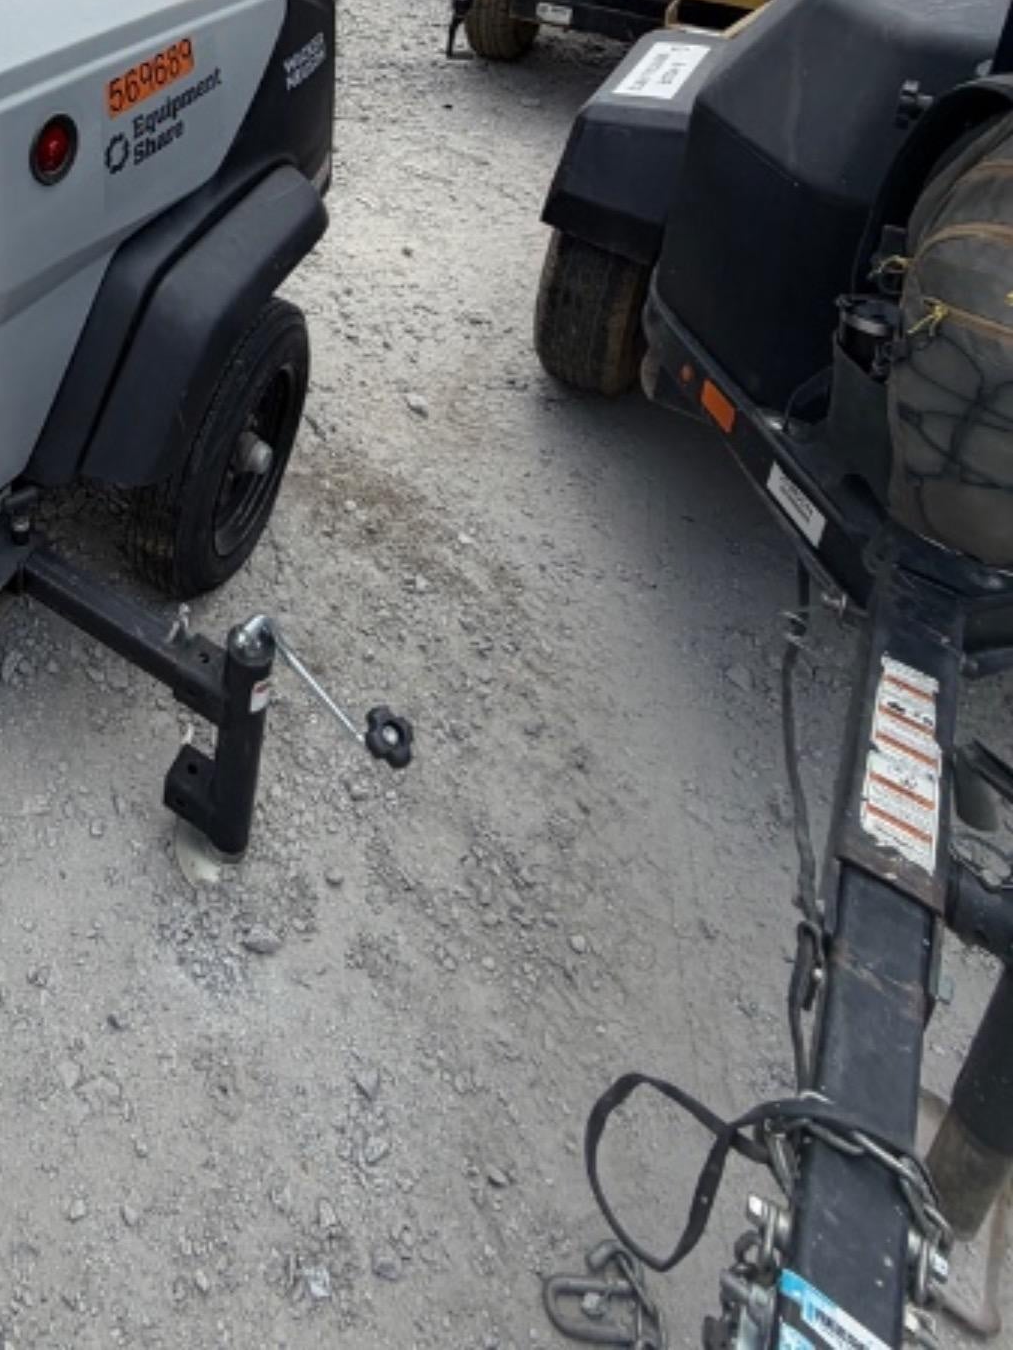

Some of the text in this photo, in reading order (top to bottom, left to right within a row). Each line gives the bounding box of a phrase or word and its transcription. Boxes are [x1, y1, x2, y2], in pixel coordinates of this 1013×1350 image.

[109, 37, 192, 112] 569689
[132, 66, 222, 139] Equipment
[132, 120, 184, 166] Share
